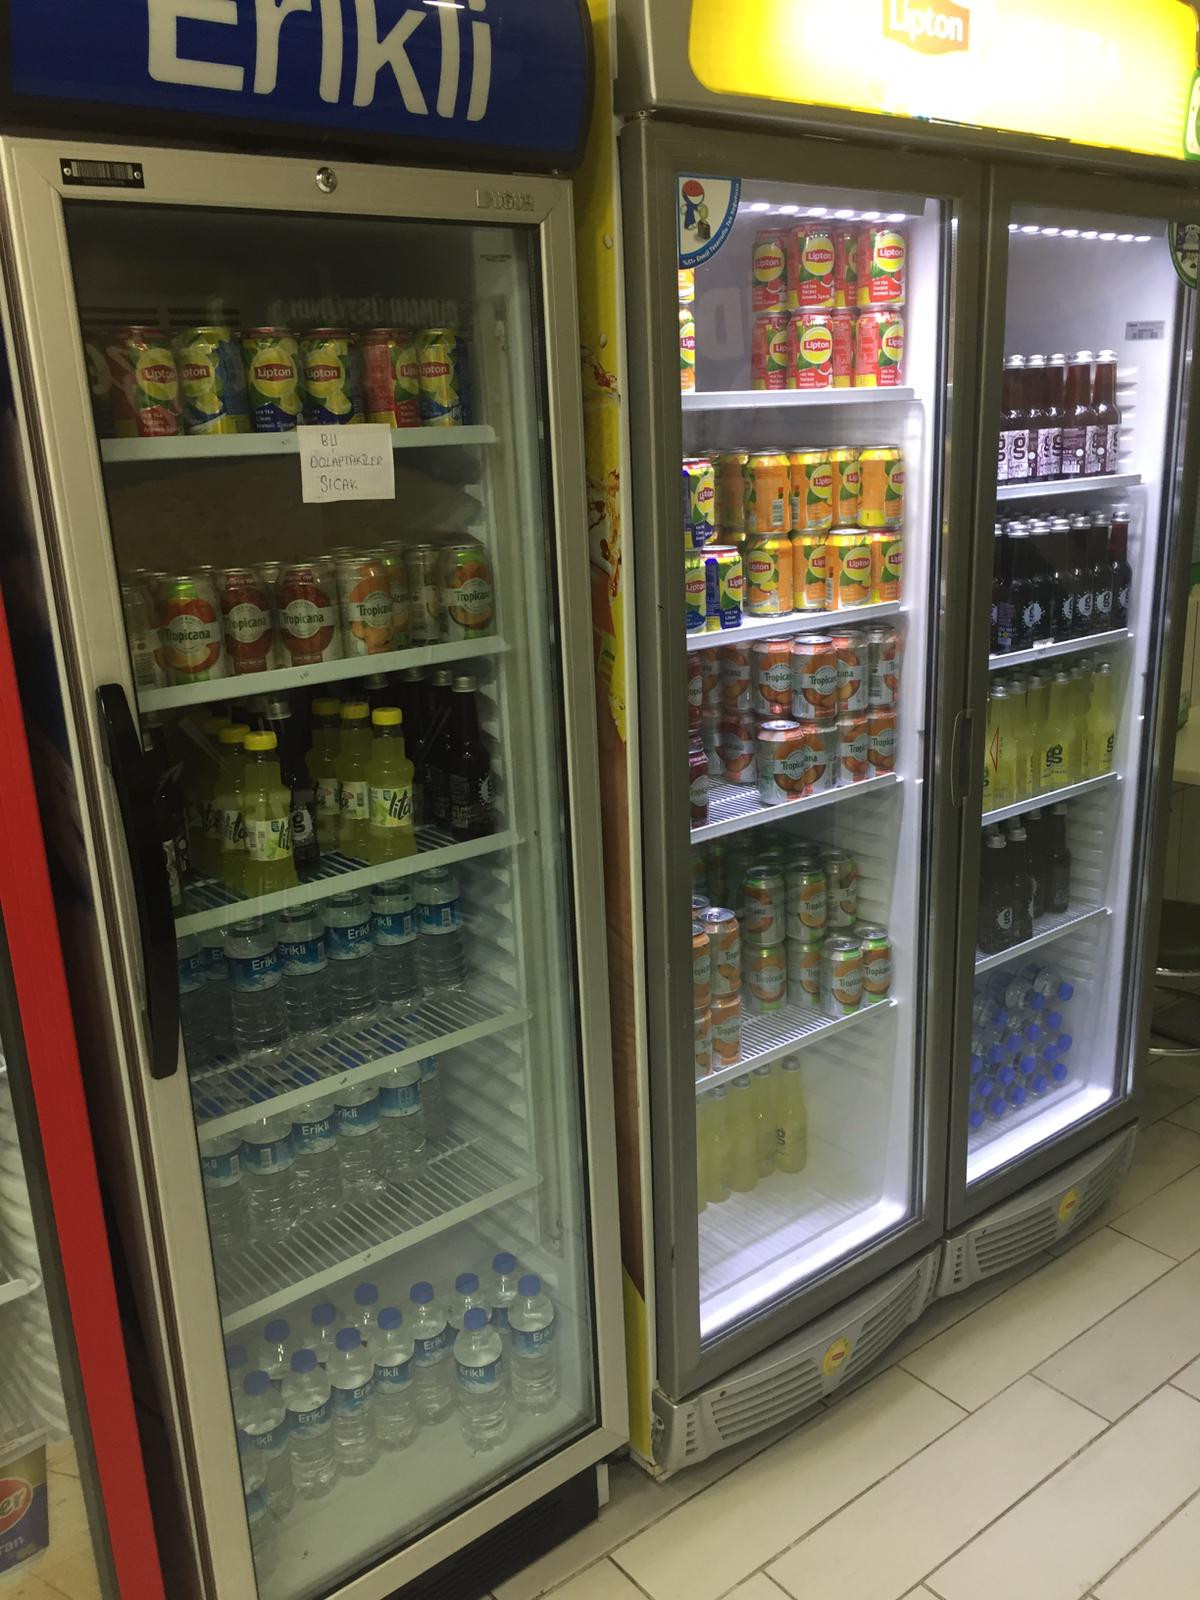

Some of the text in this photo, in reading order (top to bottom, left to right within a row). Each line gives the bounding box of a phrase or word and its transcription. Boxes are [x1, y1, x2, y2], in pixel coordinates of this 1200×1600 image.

[890, 0, 964, 43] Lipton
[808, 252, 832, 261] Lipton
[805, 341, 830, 350] Lipton
[256, 367, 293, 379] Lipton
[419, 365, 448, 377] Lipton
[320, 433, 338, 447] BU
[282, 611, 325, 626] Tropicana
